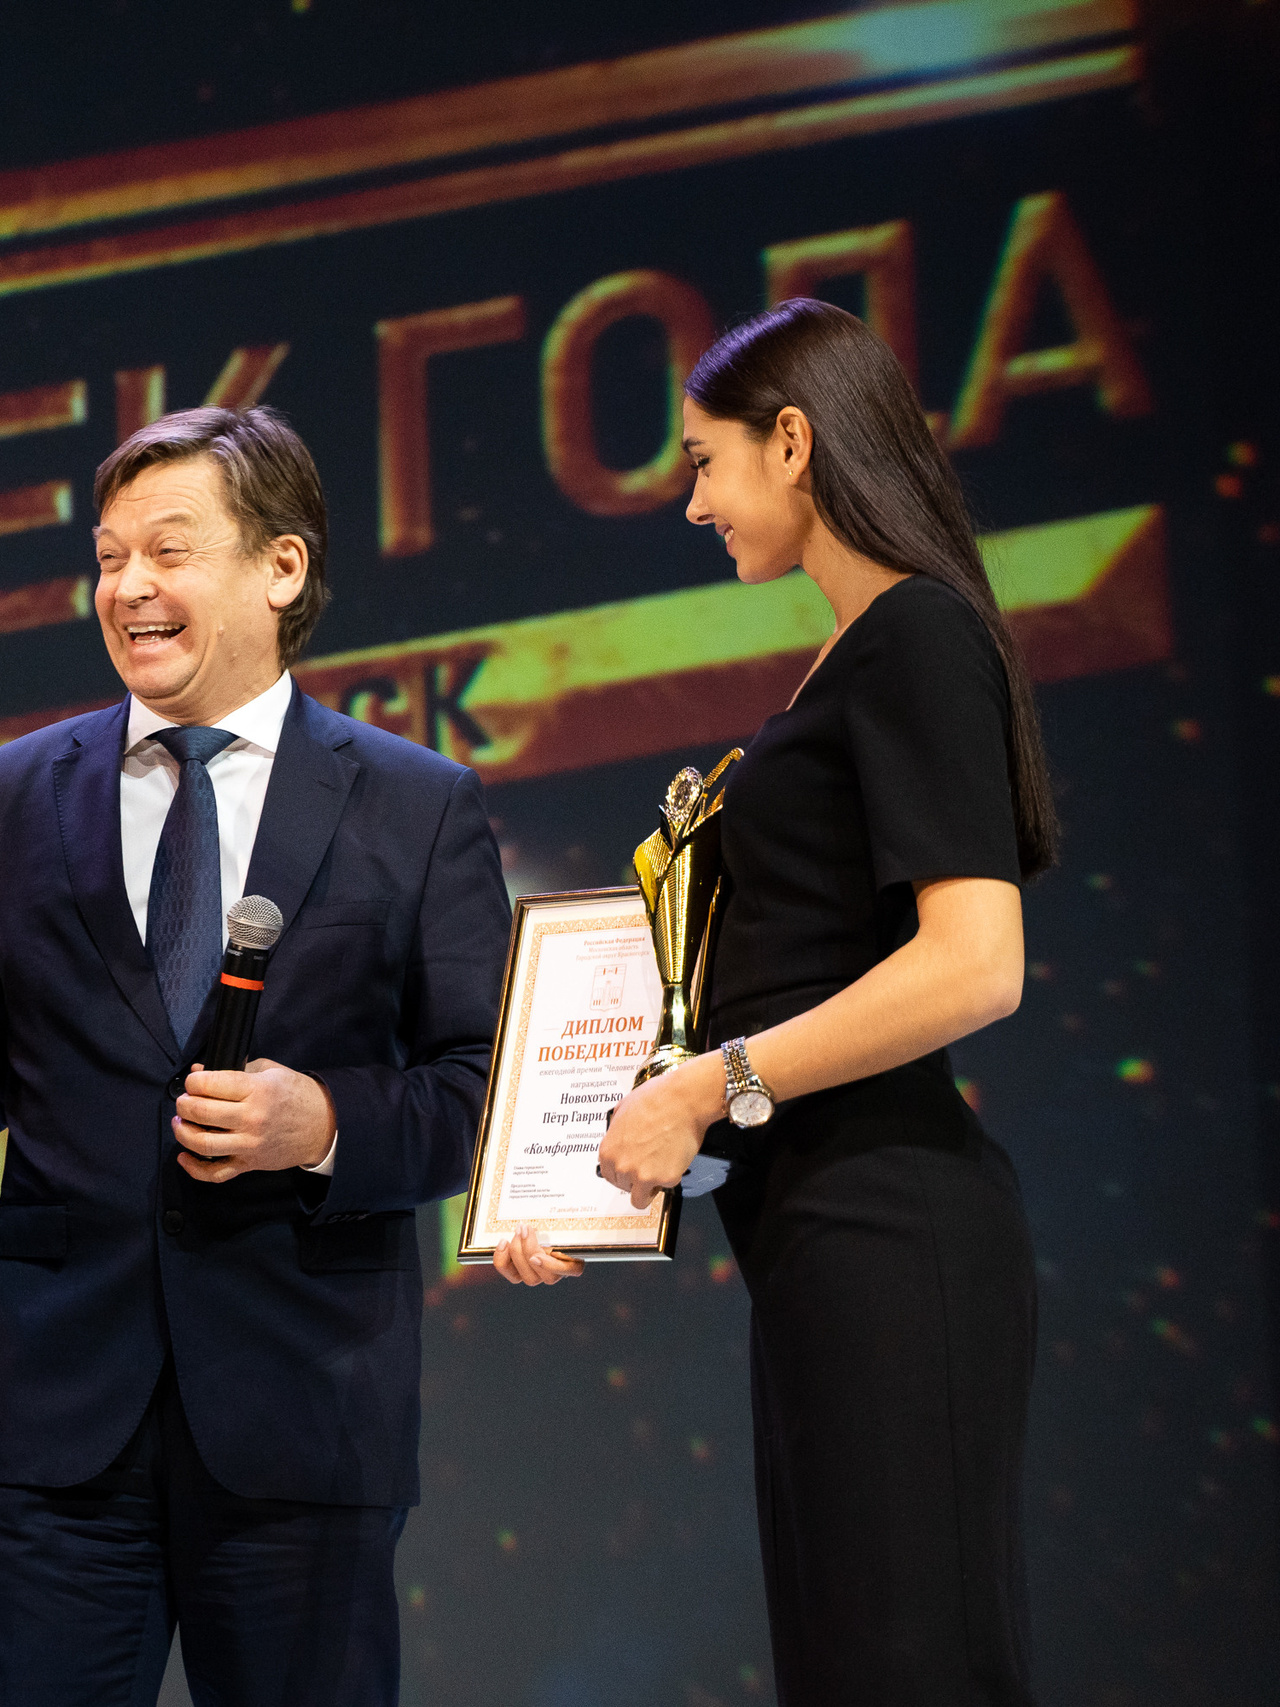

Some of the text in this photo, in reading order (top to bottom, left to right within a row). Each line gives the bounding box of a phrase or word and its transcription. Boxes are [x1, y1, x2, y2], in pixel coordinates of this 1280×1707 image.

[562, 1016, 644, 1038] ДИПЛОМ
[539, 1067, 576, 1077] ежегодной
[576, 1066, 603, 1075] премии
[570, 1080, 617, 1089] награждается
[560, 1092, 623, 1104] Новохотько
[542, 1111, 569, 1126] Пётр
[523, 1141, 599, 1157] «Комфортны
